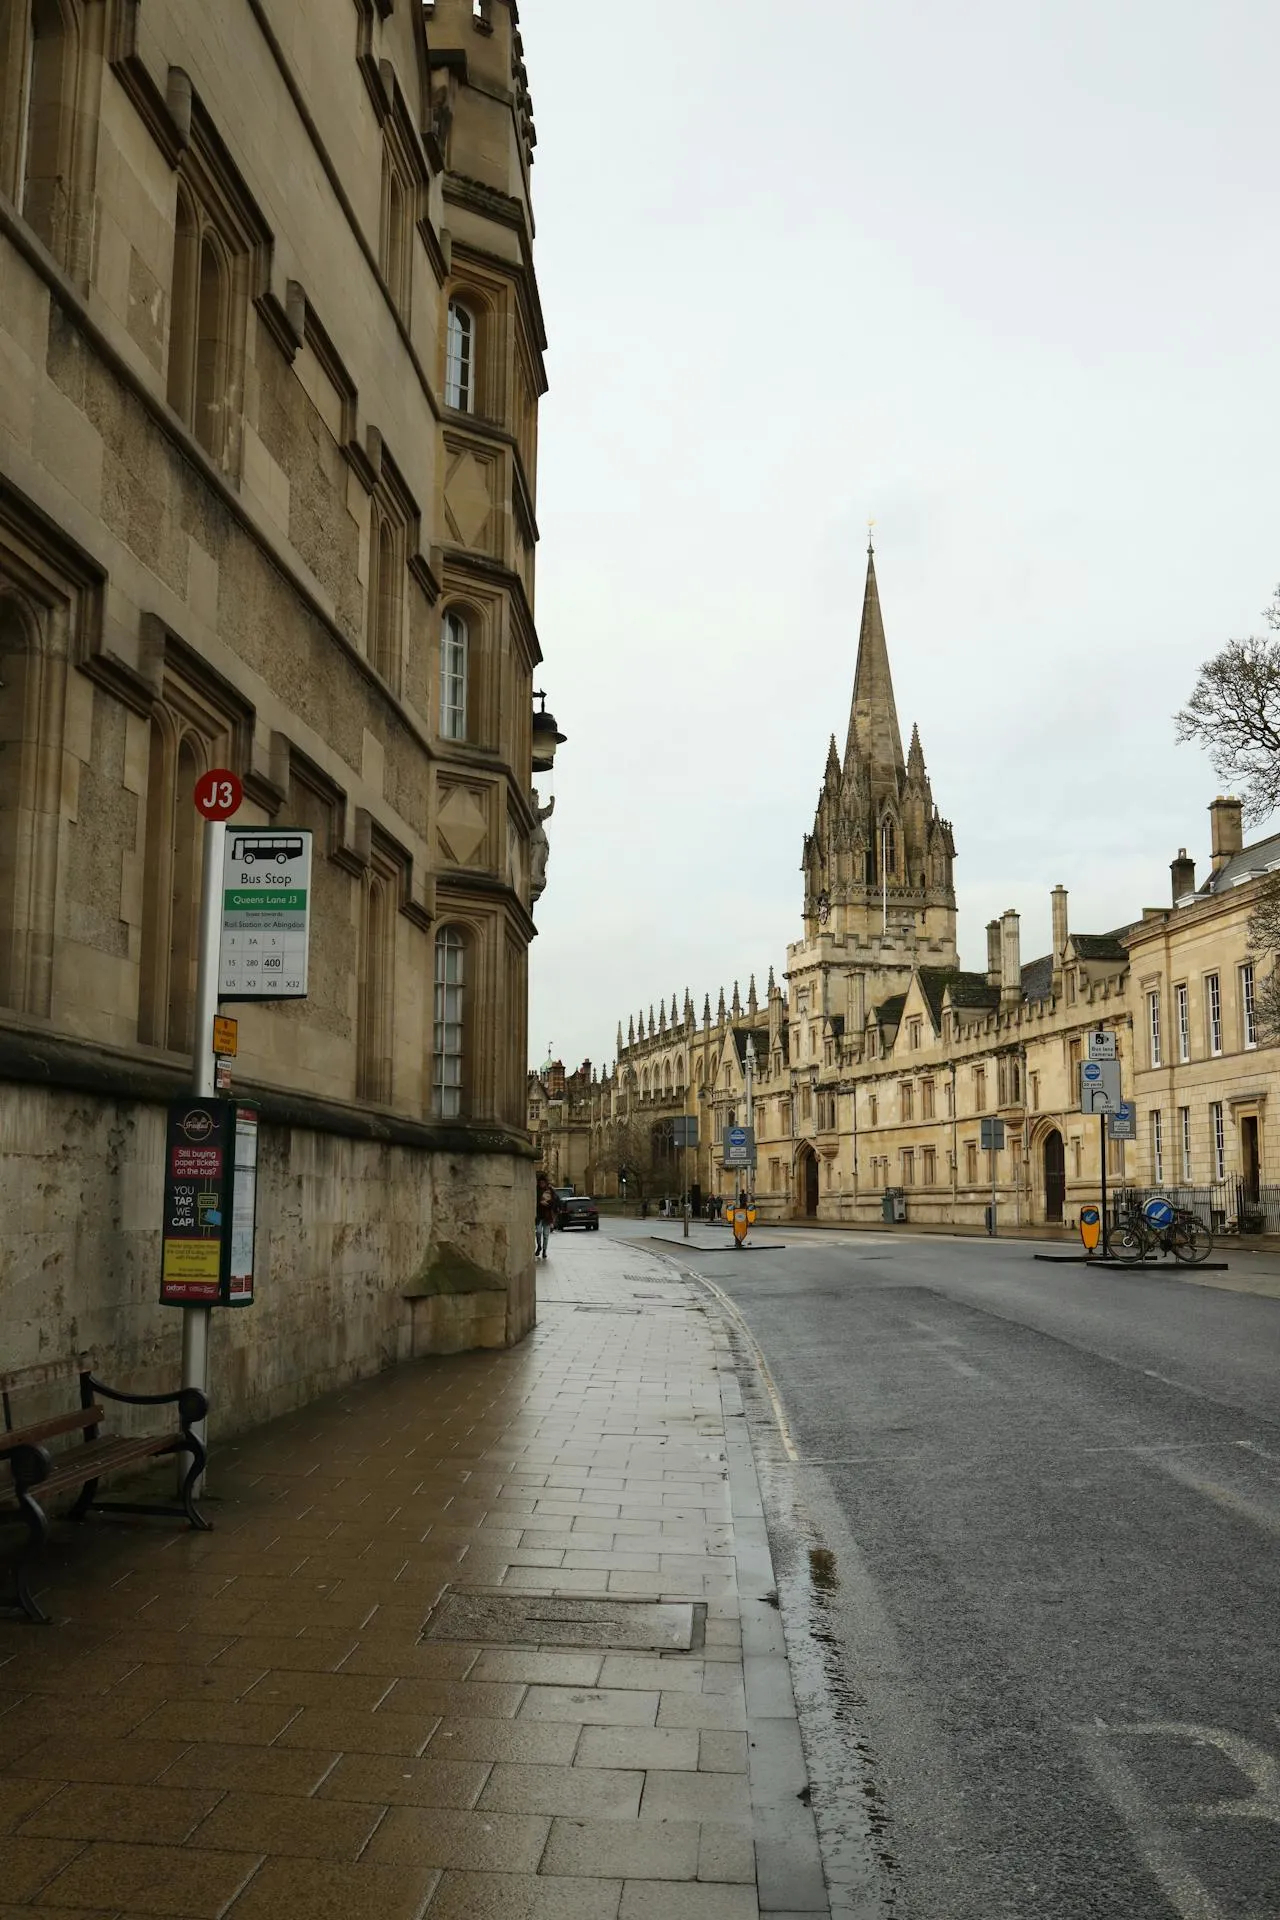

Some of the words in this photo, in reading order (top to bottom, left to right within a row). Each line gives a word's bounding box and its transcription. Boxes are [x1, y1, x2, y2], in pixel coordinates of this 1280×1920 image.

[203, 782, 233, 808] J3
[241, 873, 261, 884] Bus
[265, 872, 292, 887] Stop
[233, 895, 264, 905] Queens
[267, 895, 287, 904] Lane
[288, 895, 297, 904] J3
[272, 921, 305, 930] Abingdon
[228, 959, 237, 967] 15
[246, 959, 259, 967] 280
[264, 959, 281, 967] 400
[178, 1149, 191, 1158] Still
[192, 1150, 216, 1159] buying
[175, 1159, 195, 1168] paper
[196, 1159, 220, 1167] tickets
[187, 1167, 198, 1175] the
[199, 1167, 217, 1175] bus?
[174, 1185, 195, 1195] YOU
[174, 1196, 194, 1206] TAP,
[176, 1207, 191, 1217] WE
[171, 1217, 195, 1227] CAP!
